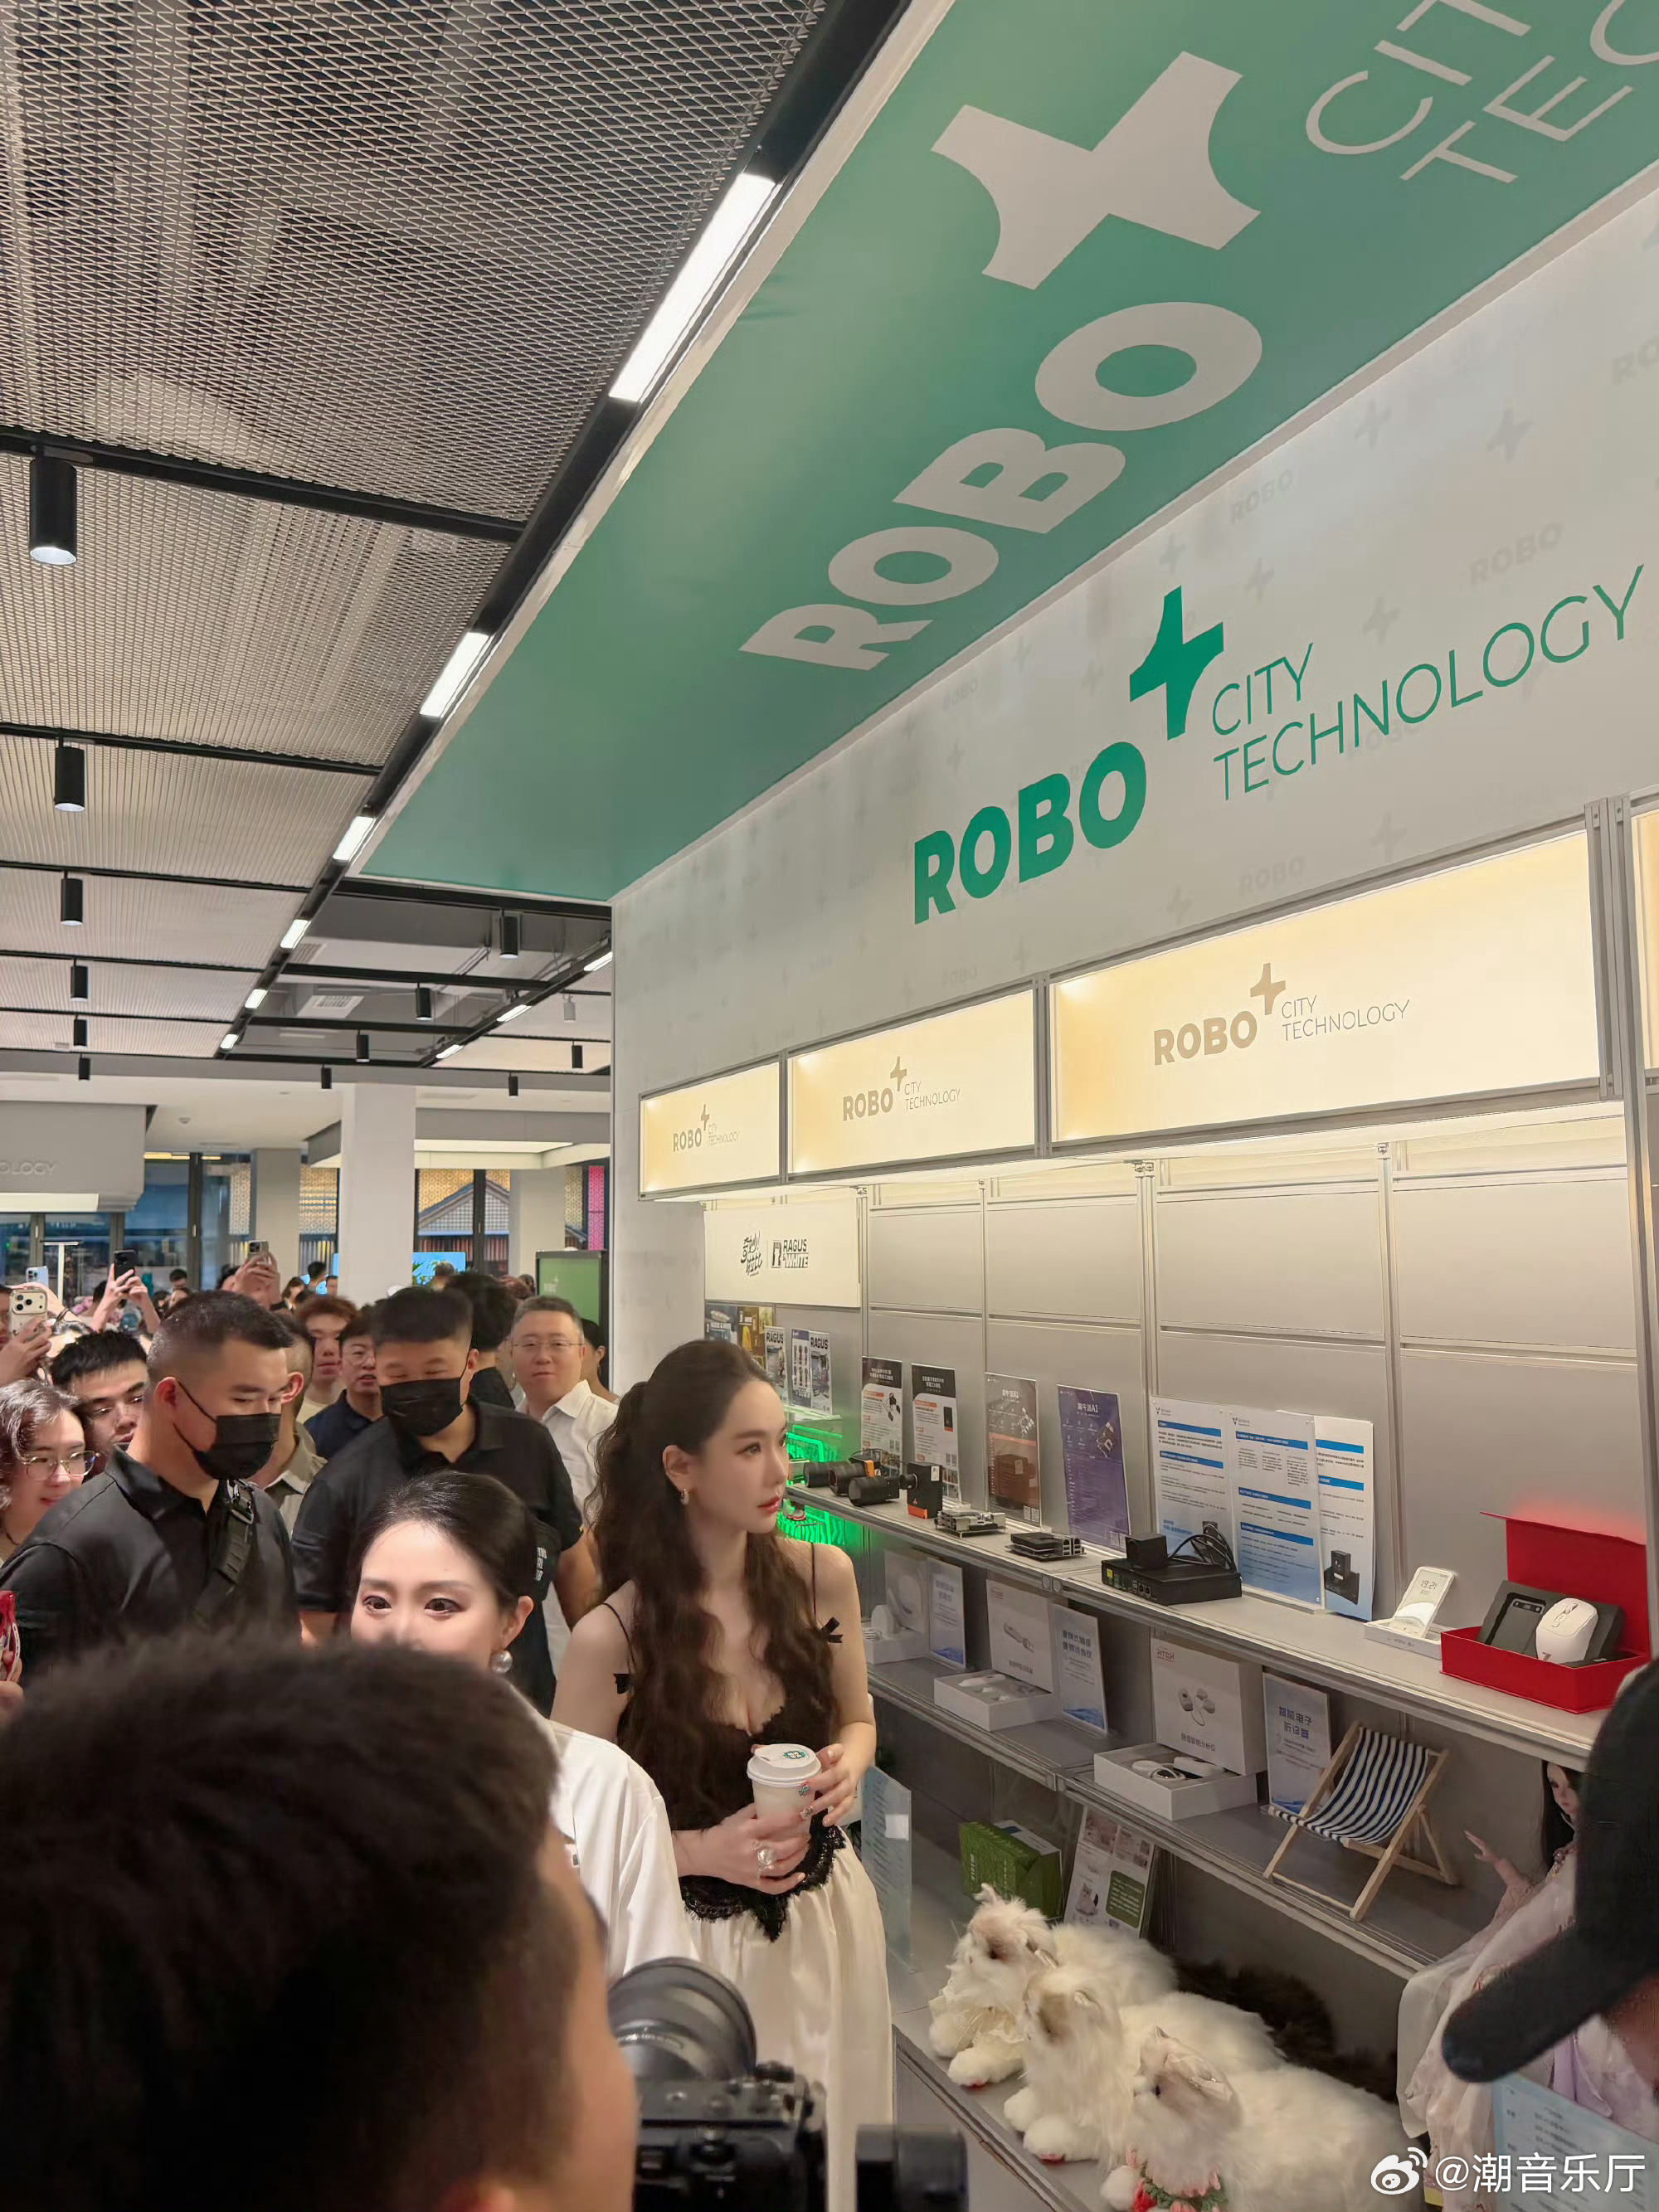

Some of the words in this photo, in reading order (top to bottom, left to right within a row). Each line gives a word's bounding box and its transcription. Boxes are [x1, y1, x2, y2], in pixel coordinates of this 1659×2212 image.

[739, 301, 1262, 672] ROBO
[1469, 521, 1564, 588] ROBO
[1212, 642, 1314, 737] CITY
[1213, 563, 1645, 801] TECHNOLOGY
[914, 741, 1148, 926] ROBO
[1281, 994, 1317, 1020] CITY
[1282, 999, 1410, 1042] TECHNOLOGY
[1154, 1010, 1258, 1066] ROBO
[904, 1081, 922, 1096] CITY
[905, 1087, 961, 1111] TECHNOLOGY
[842, 1087, 893, 1121] ROBO
[673, 1127, 702, 1152] ROBO
[783, 1238, 808, 1252] RAGUS
[766, 1332, 785, 1344] RAGUS
[810, 1336, 829, 1350] RAGUS
[1278, 1705, 1313, 1727] 智能电子
[1283, 1720, 1311, 1740] 听诊器
